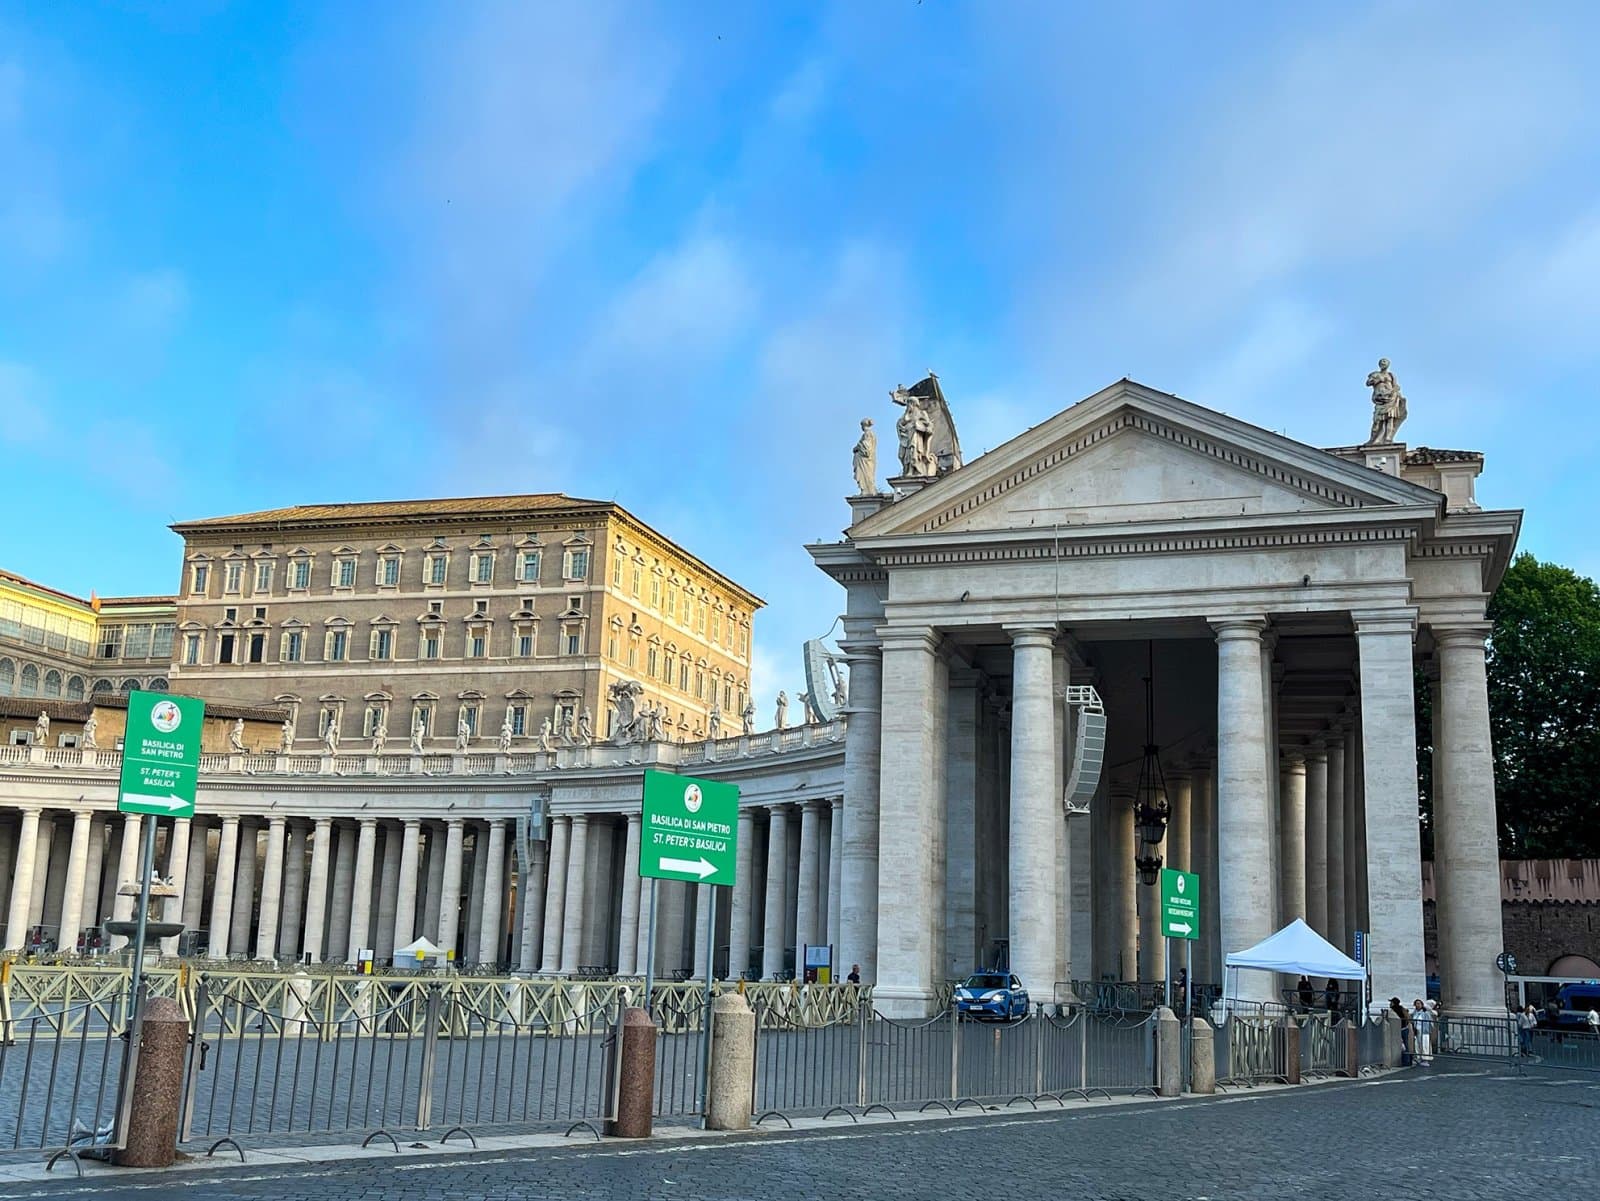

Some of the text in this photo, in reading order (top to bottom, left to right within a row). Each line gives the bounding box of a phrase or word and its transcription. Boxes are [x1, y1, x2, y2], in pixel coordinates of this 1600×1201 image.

[142, 739, 184, 751] BASILICA DI
[141, 747, 184, 759] SAN PIETRO
[140, 767, 181, 779] ST. PETER'S
[143, 777, 175, 788] BASILICA
[651, 814, 731, 834] BASILICA DI SAN PIETRO
[653, 833, 726, 852] ST. PETER'S BASILICA
